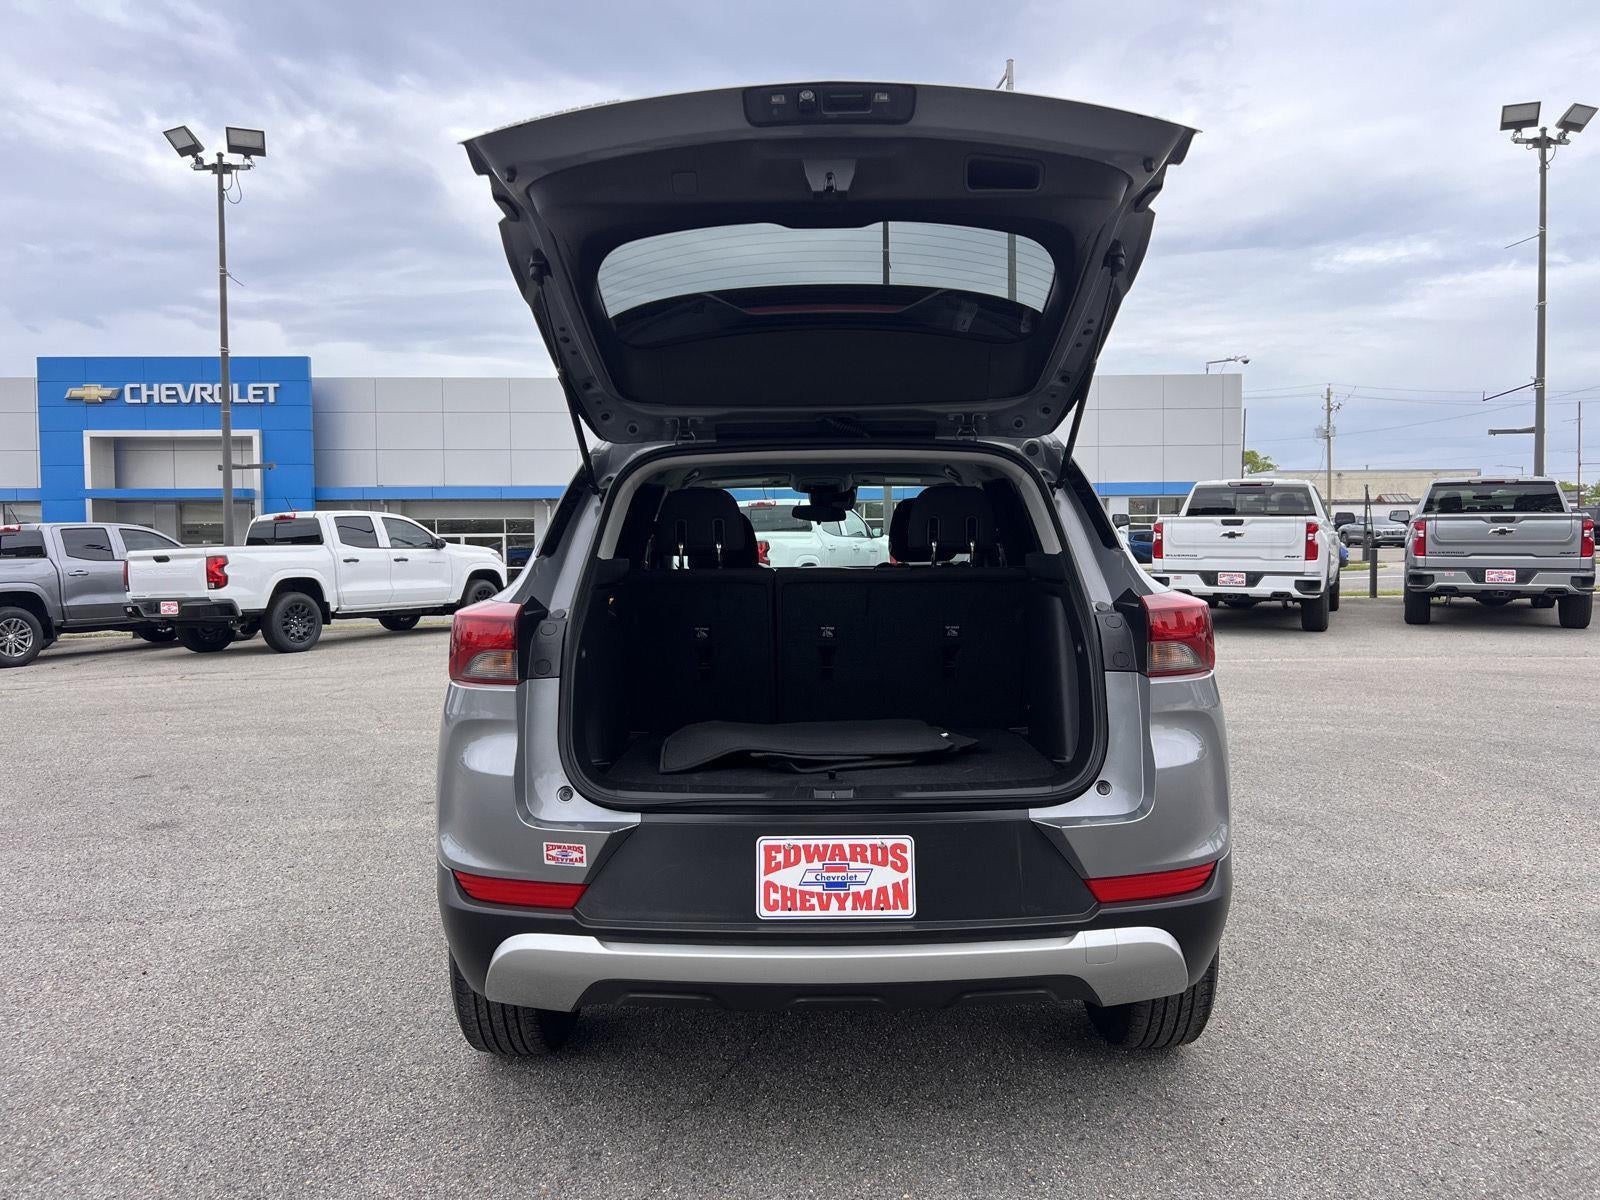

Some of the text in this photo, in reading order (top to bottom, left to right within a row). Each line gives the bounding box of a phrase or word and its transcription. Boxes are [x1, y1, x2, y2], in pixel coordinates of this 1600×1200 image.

[545, 843, 584, 855] EDWARDS
[545, 852, 584, 864] CHEVYMAN
[763, 842, 909, 876] EDWARDS
[814, 872, 858, 882] Chevrolet
[763, 877, 910, 912] CHEVYMAN
